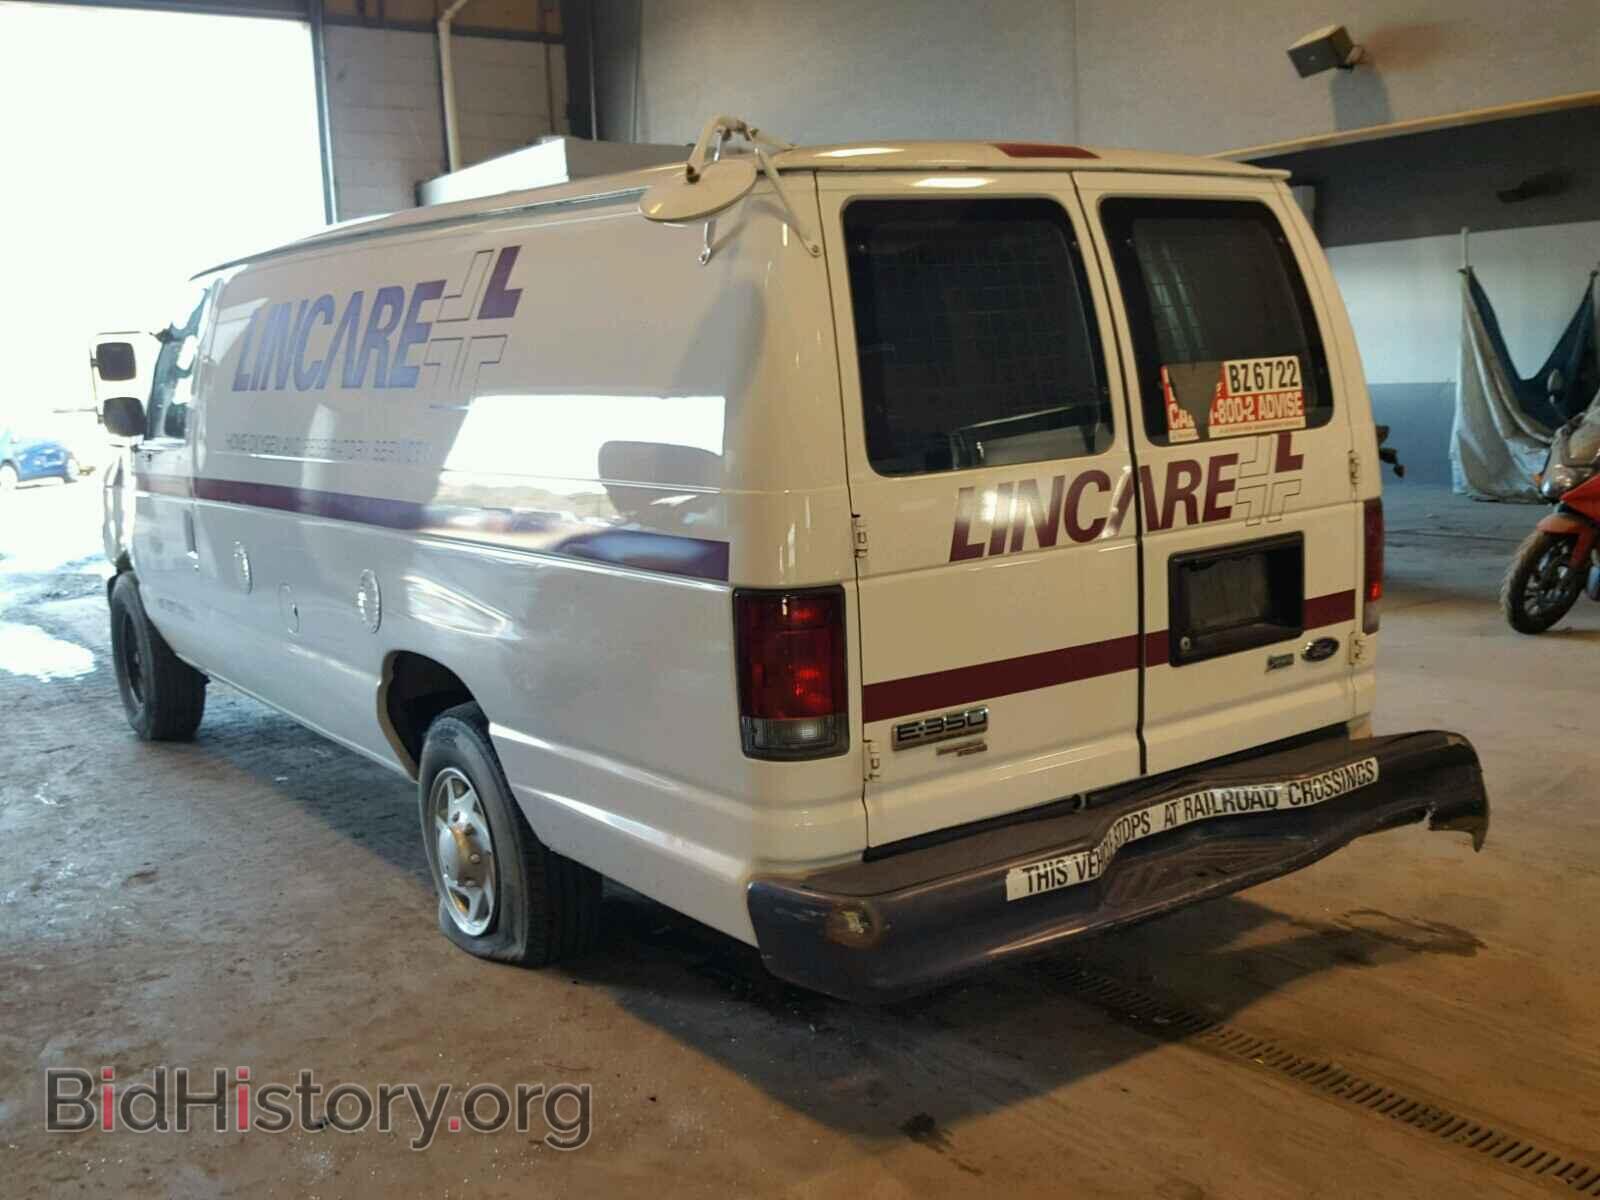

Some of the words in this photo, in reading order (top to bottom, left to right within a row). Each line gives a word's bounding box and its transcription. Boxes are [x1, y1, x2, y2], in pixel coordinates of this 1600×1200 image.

[232, 280, 447, 391] LINCARE
[1228, 360, 1299, 392] BZ6722
[1258, 392, 1304, 420] ADVISE
[949, 453, 1239, 563] LINCARE
[1022, 860, 1068, 894] THIS
[1113, 811, 1152, 849] STOPS
[1163, 801, 1182, 829] AT
[1184, 786, 1280, 823] RAILROAD
[1288, 761, 1376, 807] CROSSINGS
